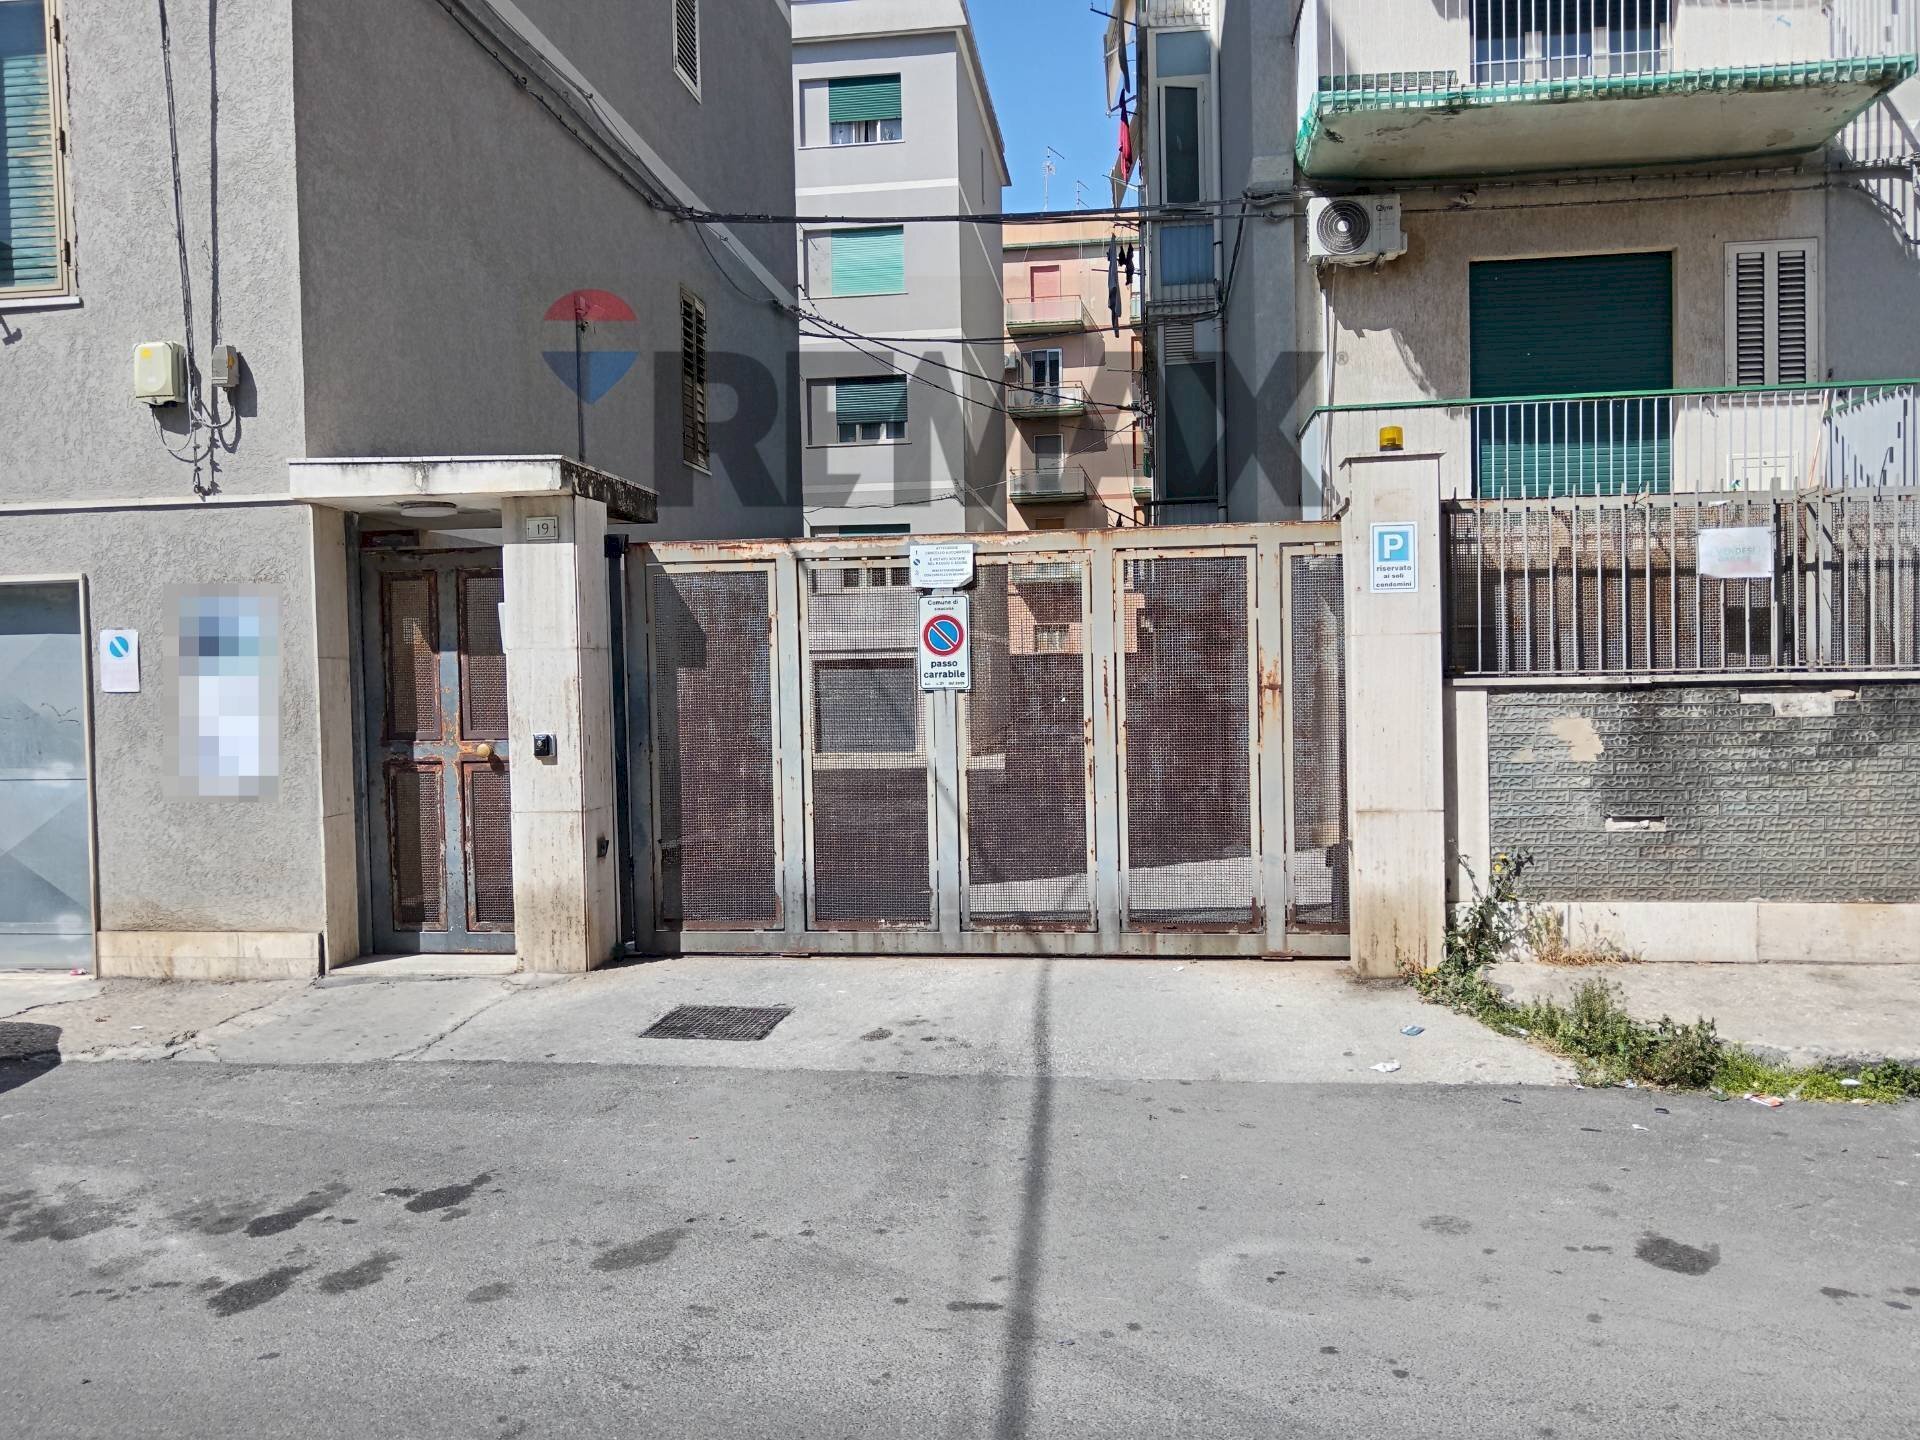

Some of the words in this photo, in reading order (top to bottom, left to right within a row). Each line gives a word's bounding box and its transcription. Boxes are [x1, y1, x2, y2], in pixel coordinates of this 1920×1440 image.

[536, 522, 549, 535] 19
[1383, 533, 1404, 559] P
[930, 660, 958, 669] passo
[923, 669, 966, 679] carrabile
